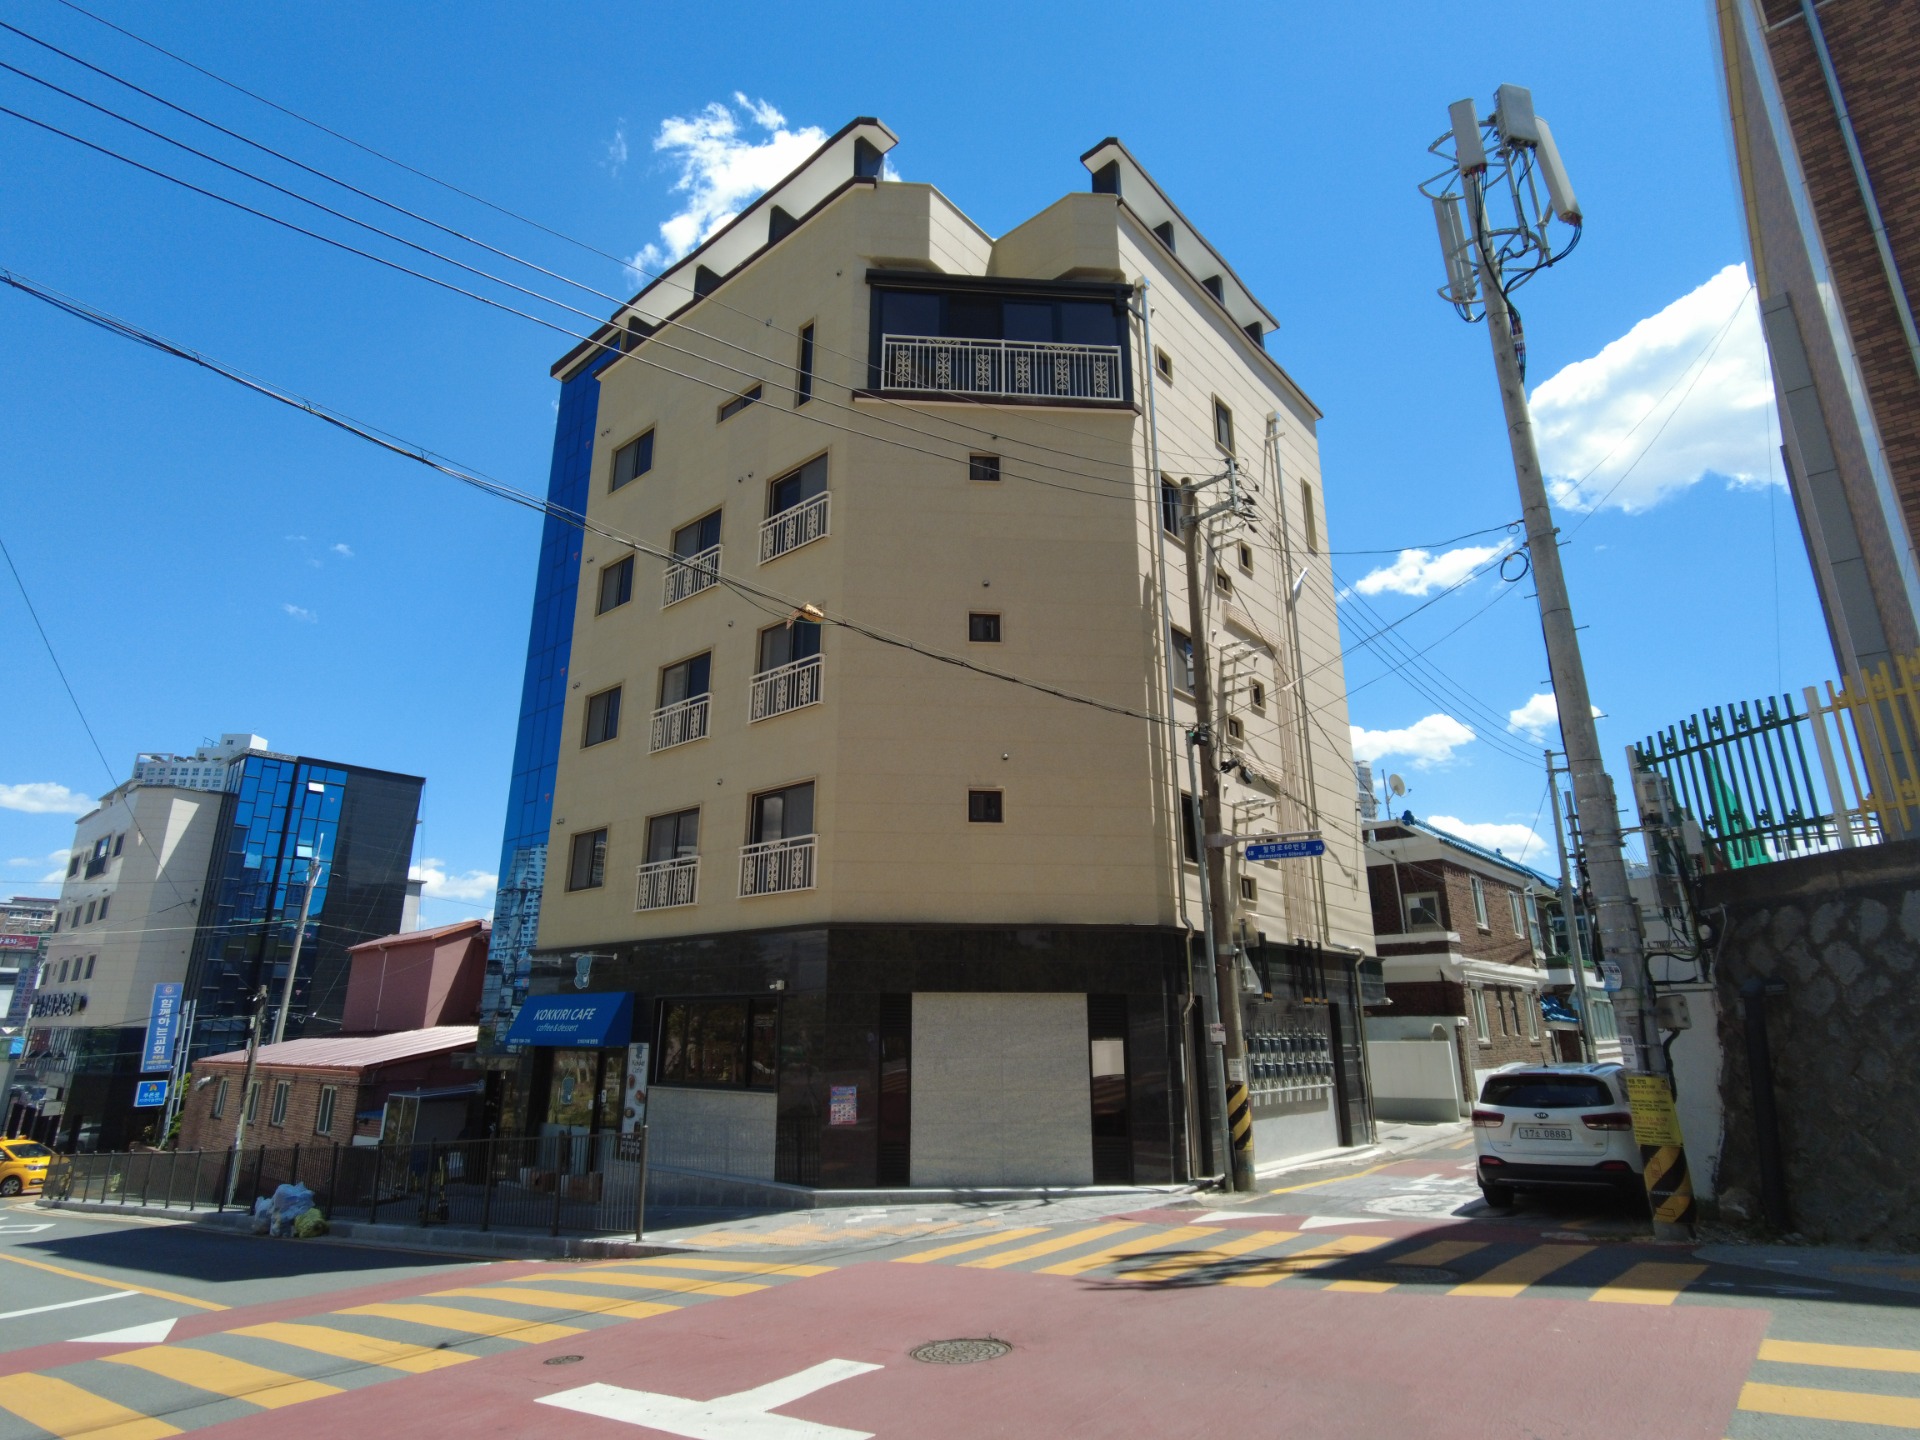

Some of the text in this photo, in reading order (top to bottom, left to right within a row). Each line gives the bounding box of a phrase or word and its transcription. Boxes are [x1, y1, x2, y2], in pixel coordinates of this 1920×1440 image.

[533, 1007, 597, 1021] KOKKIRI CAFE
[1524, 1129, 1567, 1139] 17소 0888
